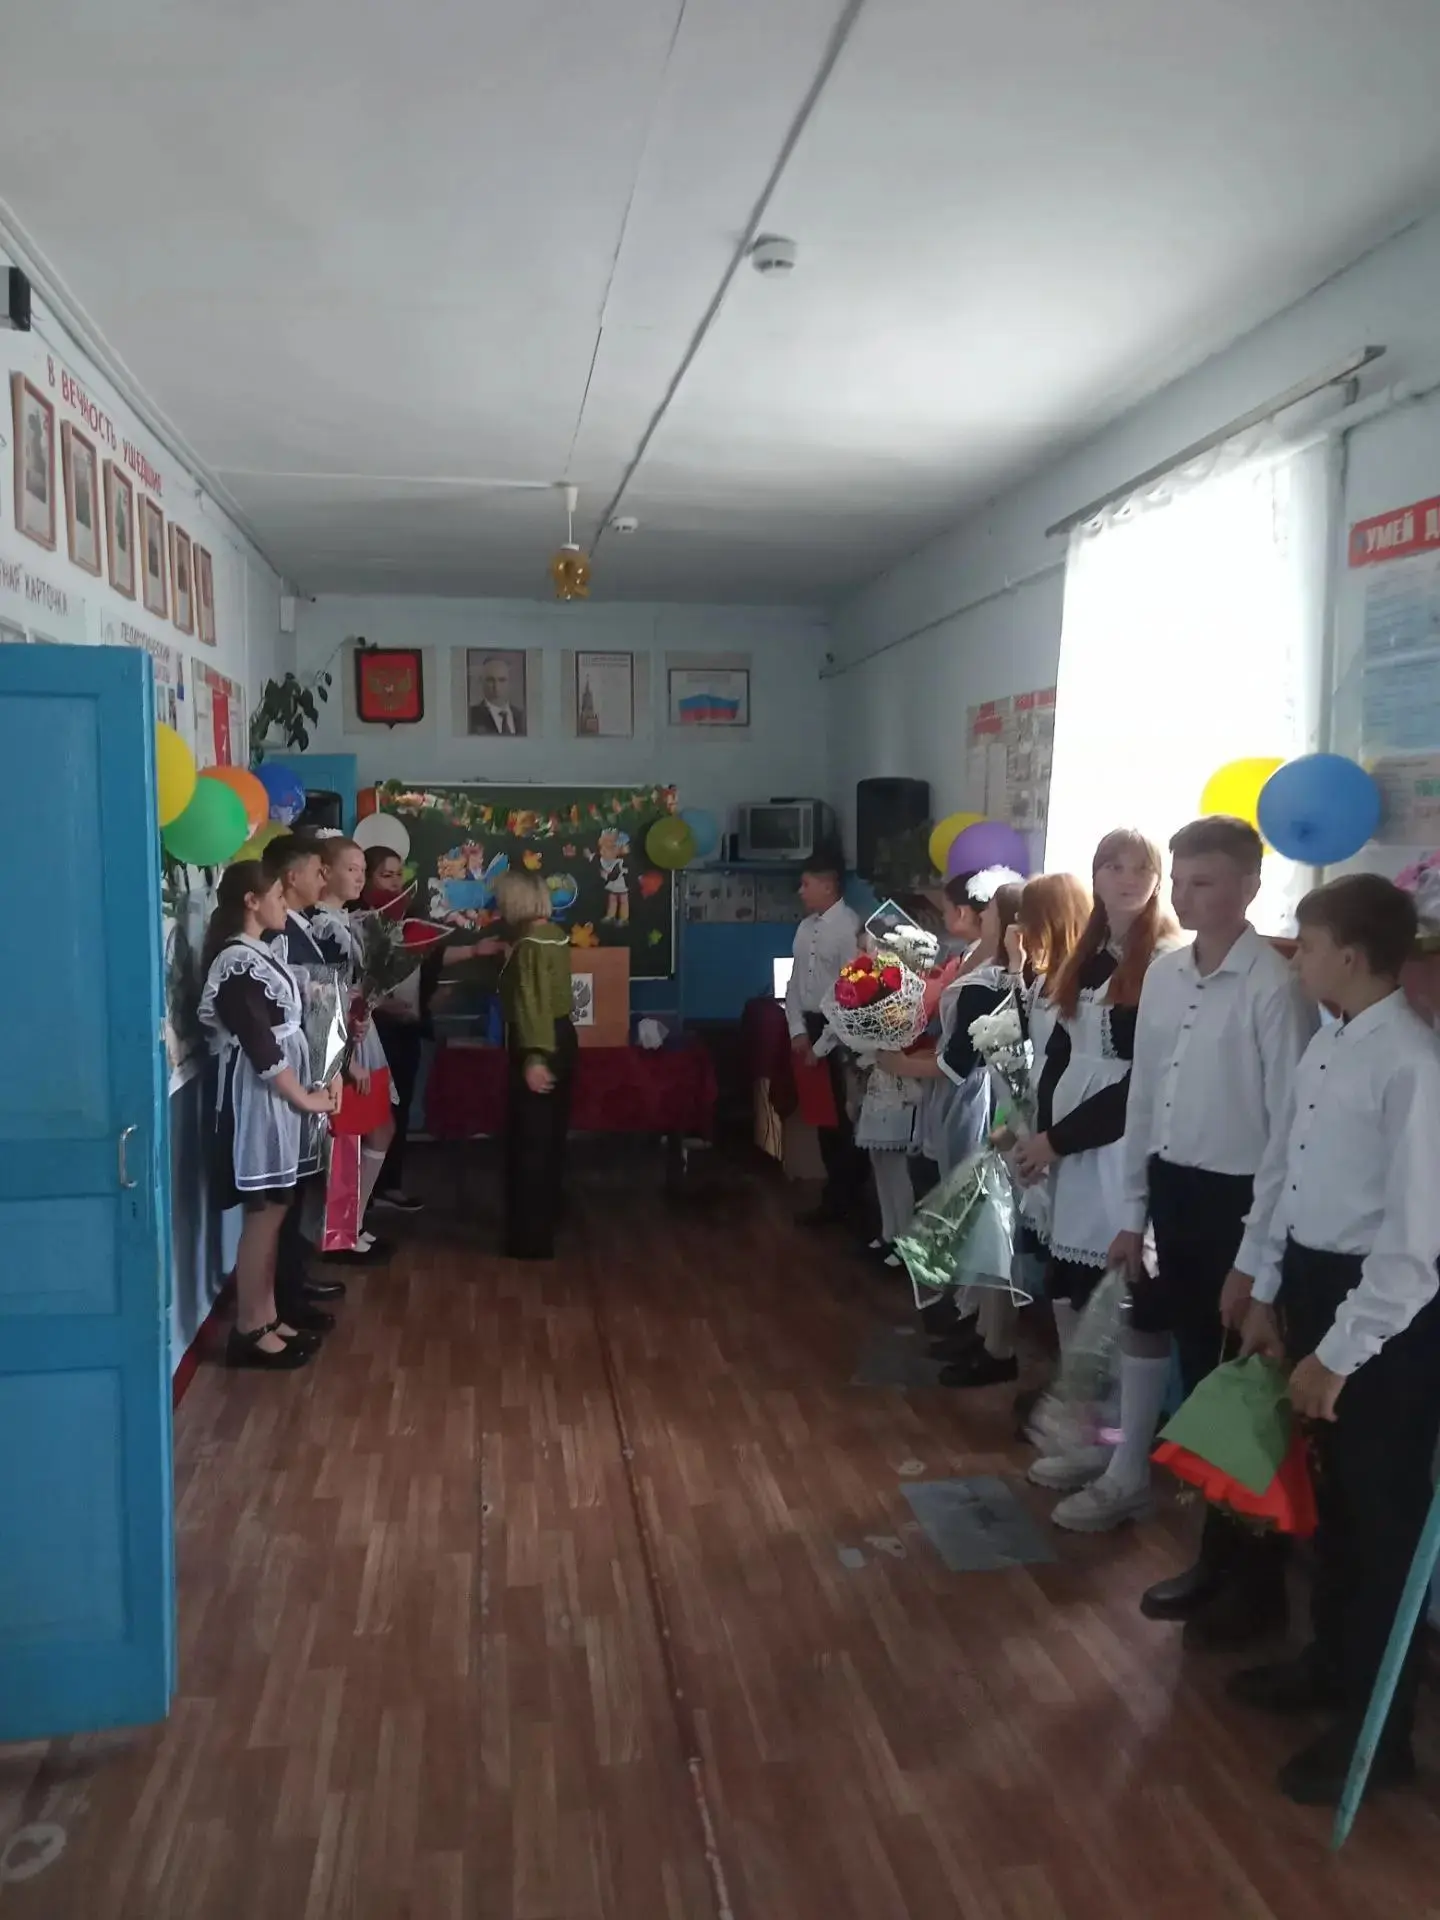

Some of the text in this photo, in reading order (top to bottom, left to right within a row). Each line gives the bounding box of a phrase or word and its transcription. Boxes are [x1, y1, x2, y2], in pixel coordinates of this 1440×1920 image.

[47, 354, 55, 388] В
[62, 368, 116, 451] ВЕЧНОСТЬ
[1366, 508, 1414, 554] УМЕЙ
